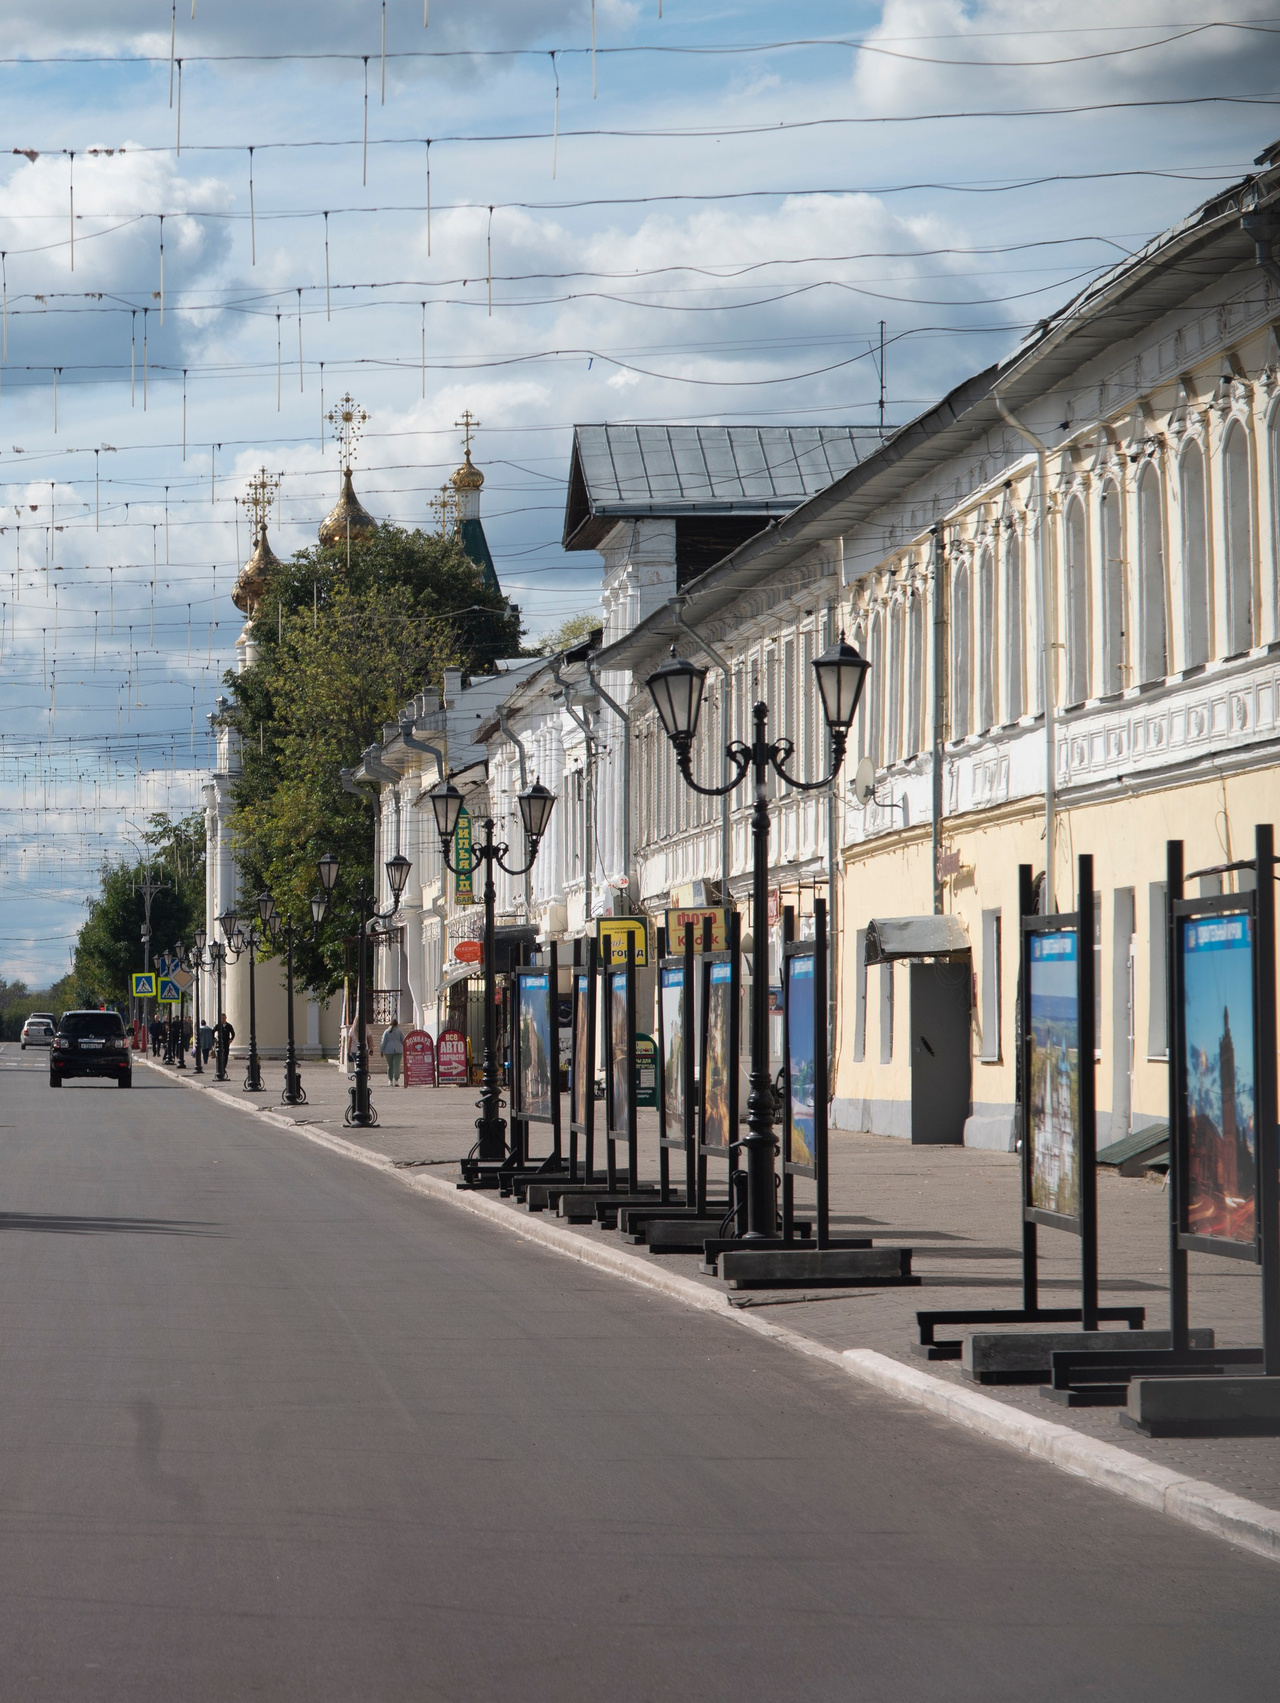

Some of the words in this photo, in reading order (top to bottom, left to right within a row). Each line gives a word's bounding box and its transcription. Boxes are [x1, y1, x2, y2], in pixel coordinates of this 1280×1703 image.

[677, 932, 719, 946] Kdk
[608, 949, 644, 959] горд
[405, 1036, 431, 1047] ЛОМБАРД
[440, 1041, 464, 1053] АВТО
